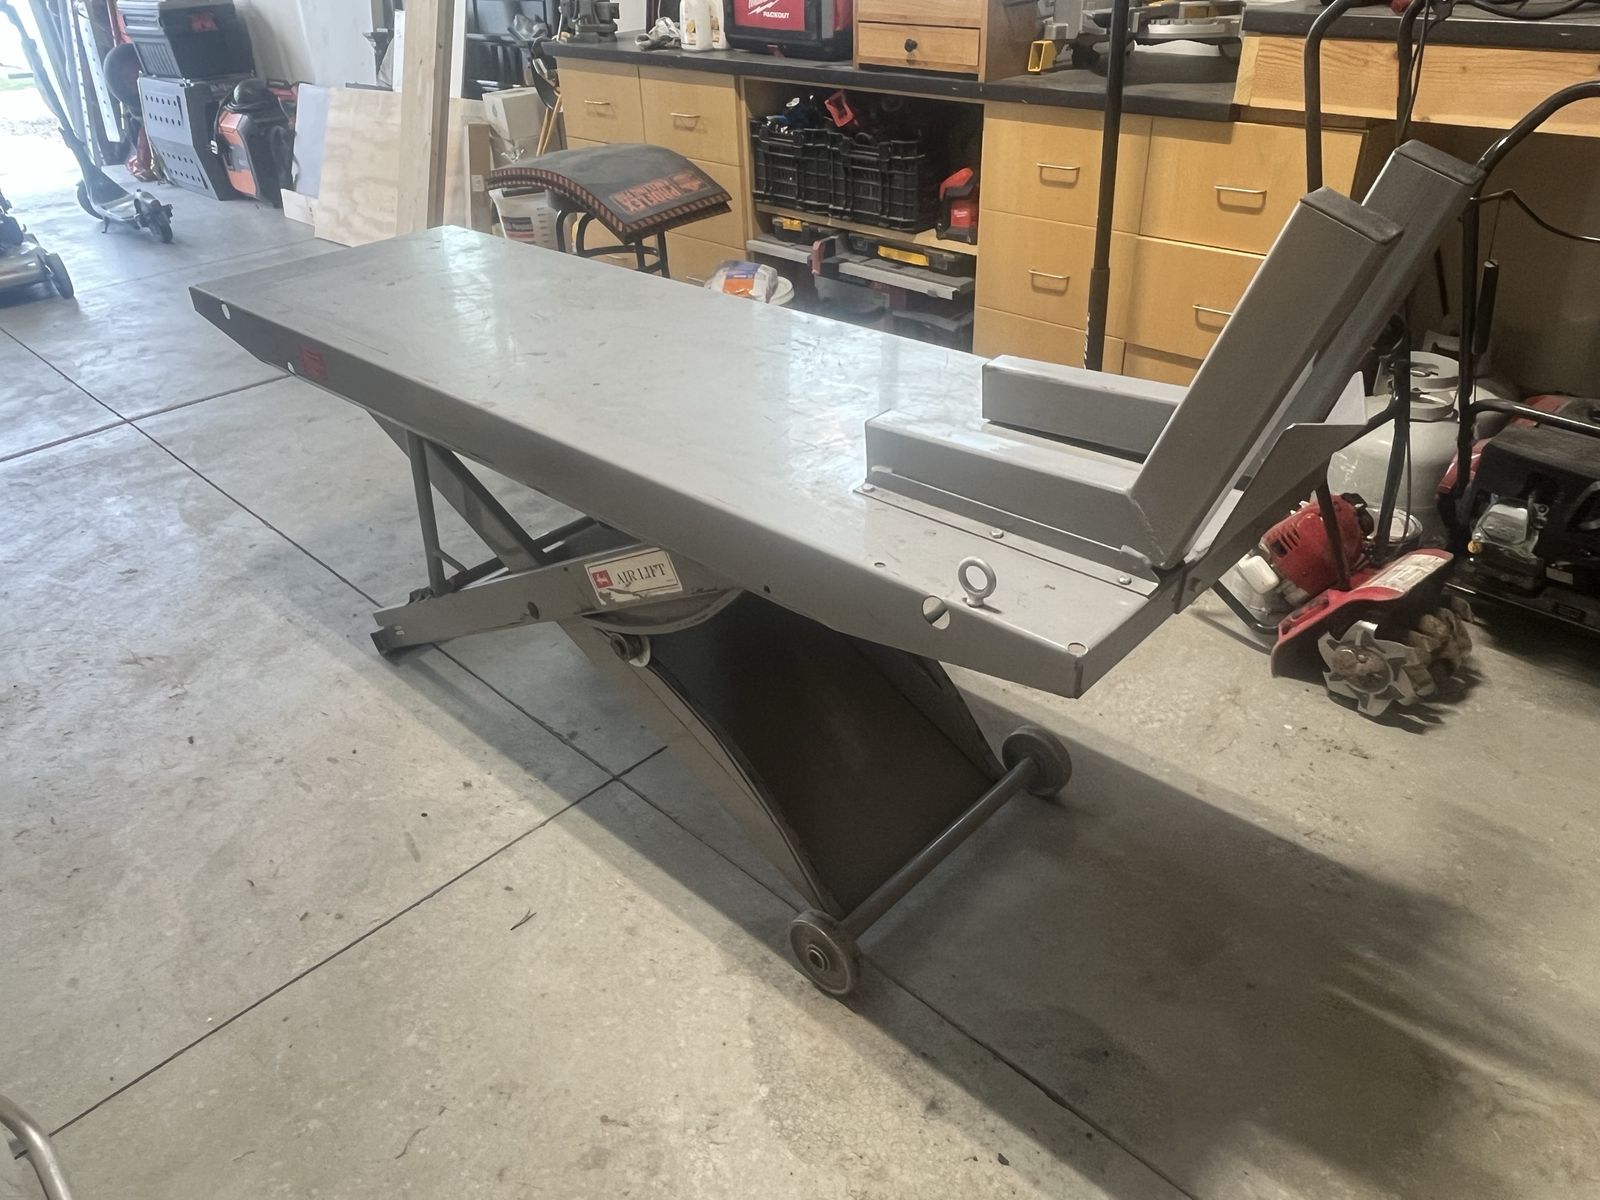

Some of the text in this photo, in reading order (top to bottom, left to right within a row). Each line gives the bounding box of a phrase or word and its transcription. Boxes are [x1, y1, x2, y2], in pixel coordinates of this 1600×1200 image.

[763, 11, 789, 19] PACKOUT
[617, 563, 666, 585] AIR LIFT
